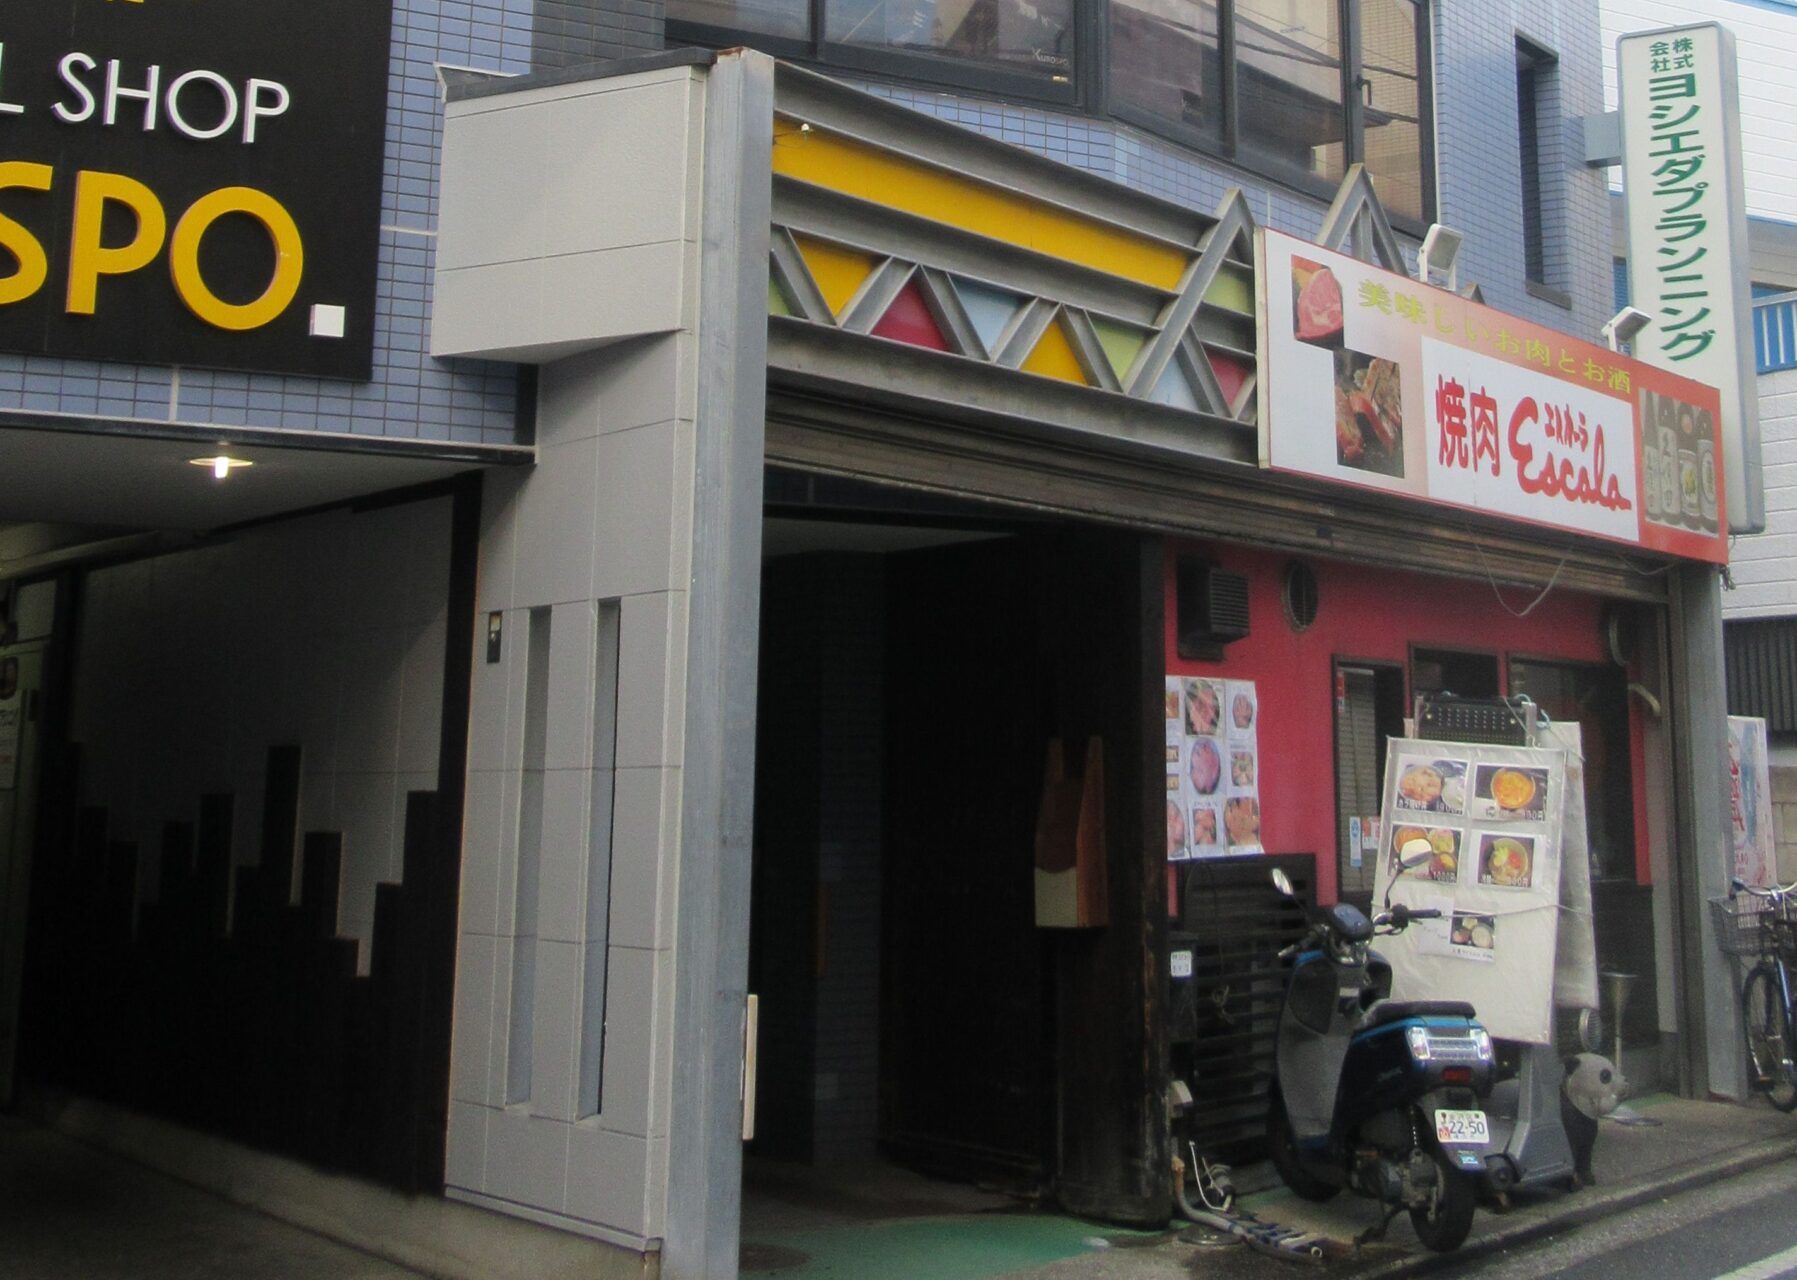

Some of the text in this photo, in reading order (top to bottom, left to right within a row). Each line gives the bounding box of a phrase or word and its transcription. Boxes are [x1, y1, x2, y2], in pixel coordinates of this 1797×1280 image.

[51, 51, 290, 144] SHOP
[1648, 73, 1716, 361] ヨシエダプランニング
[1358, 278, 1631, 394] 美味しいお肉とお酒
[1435, 373, 1501, 476] 焼肉
[1507, 396, 1632, 511] Escala
